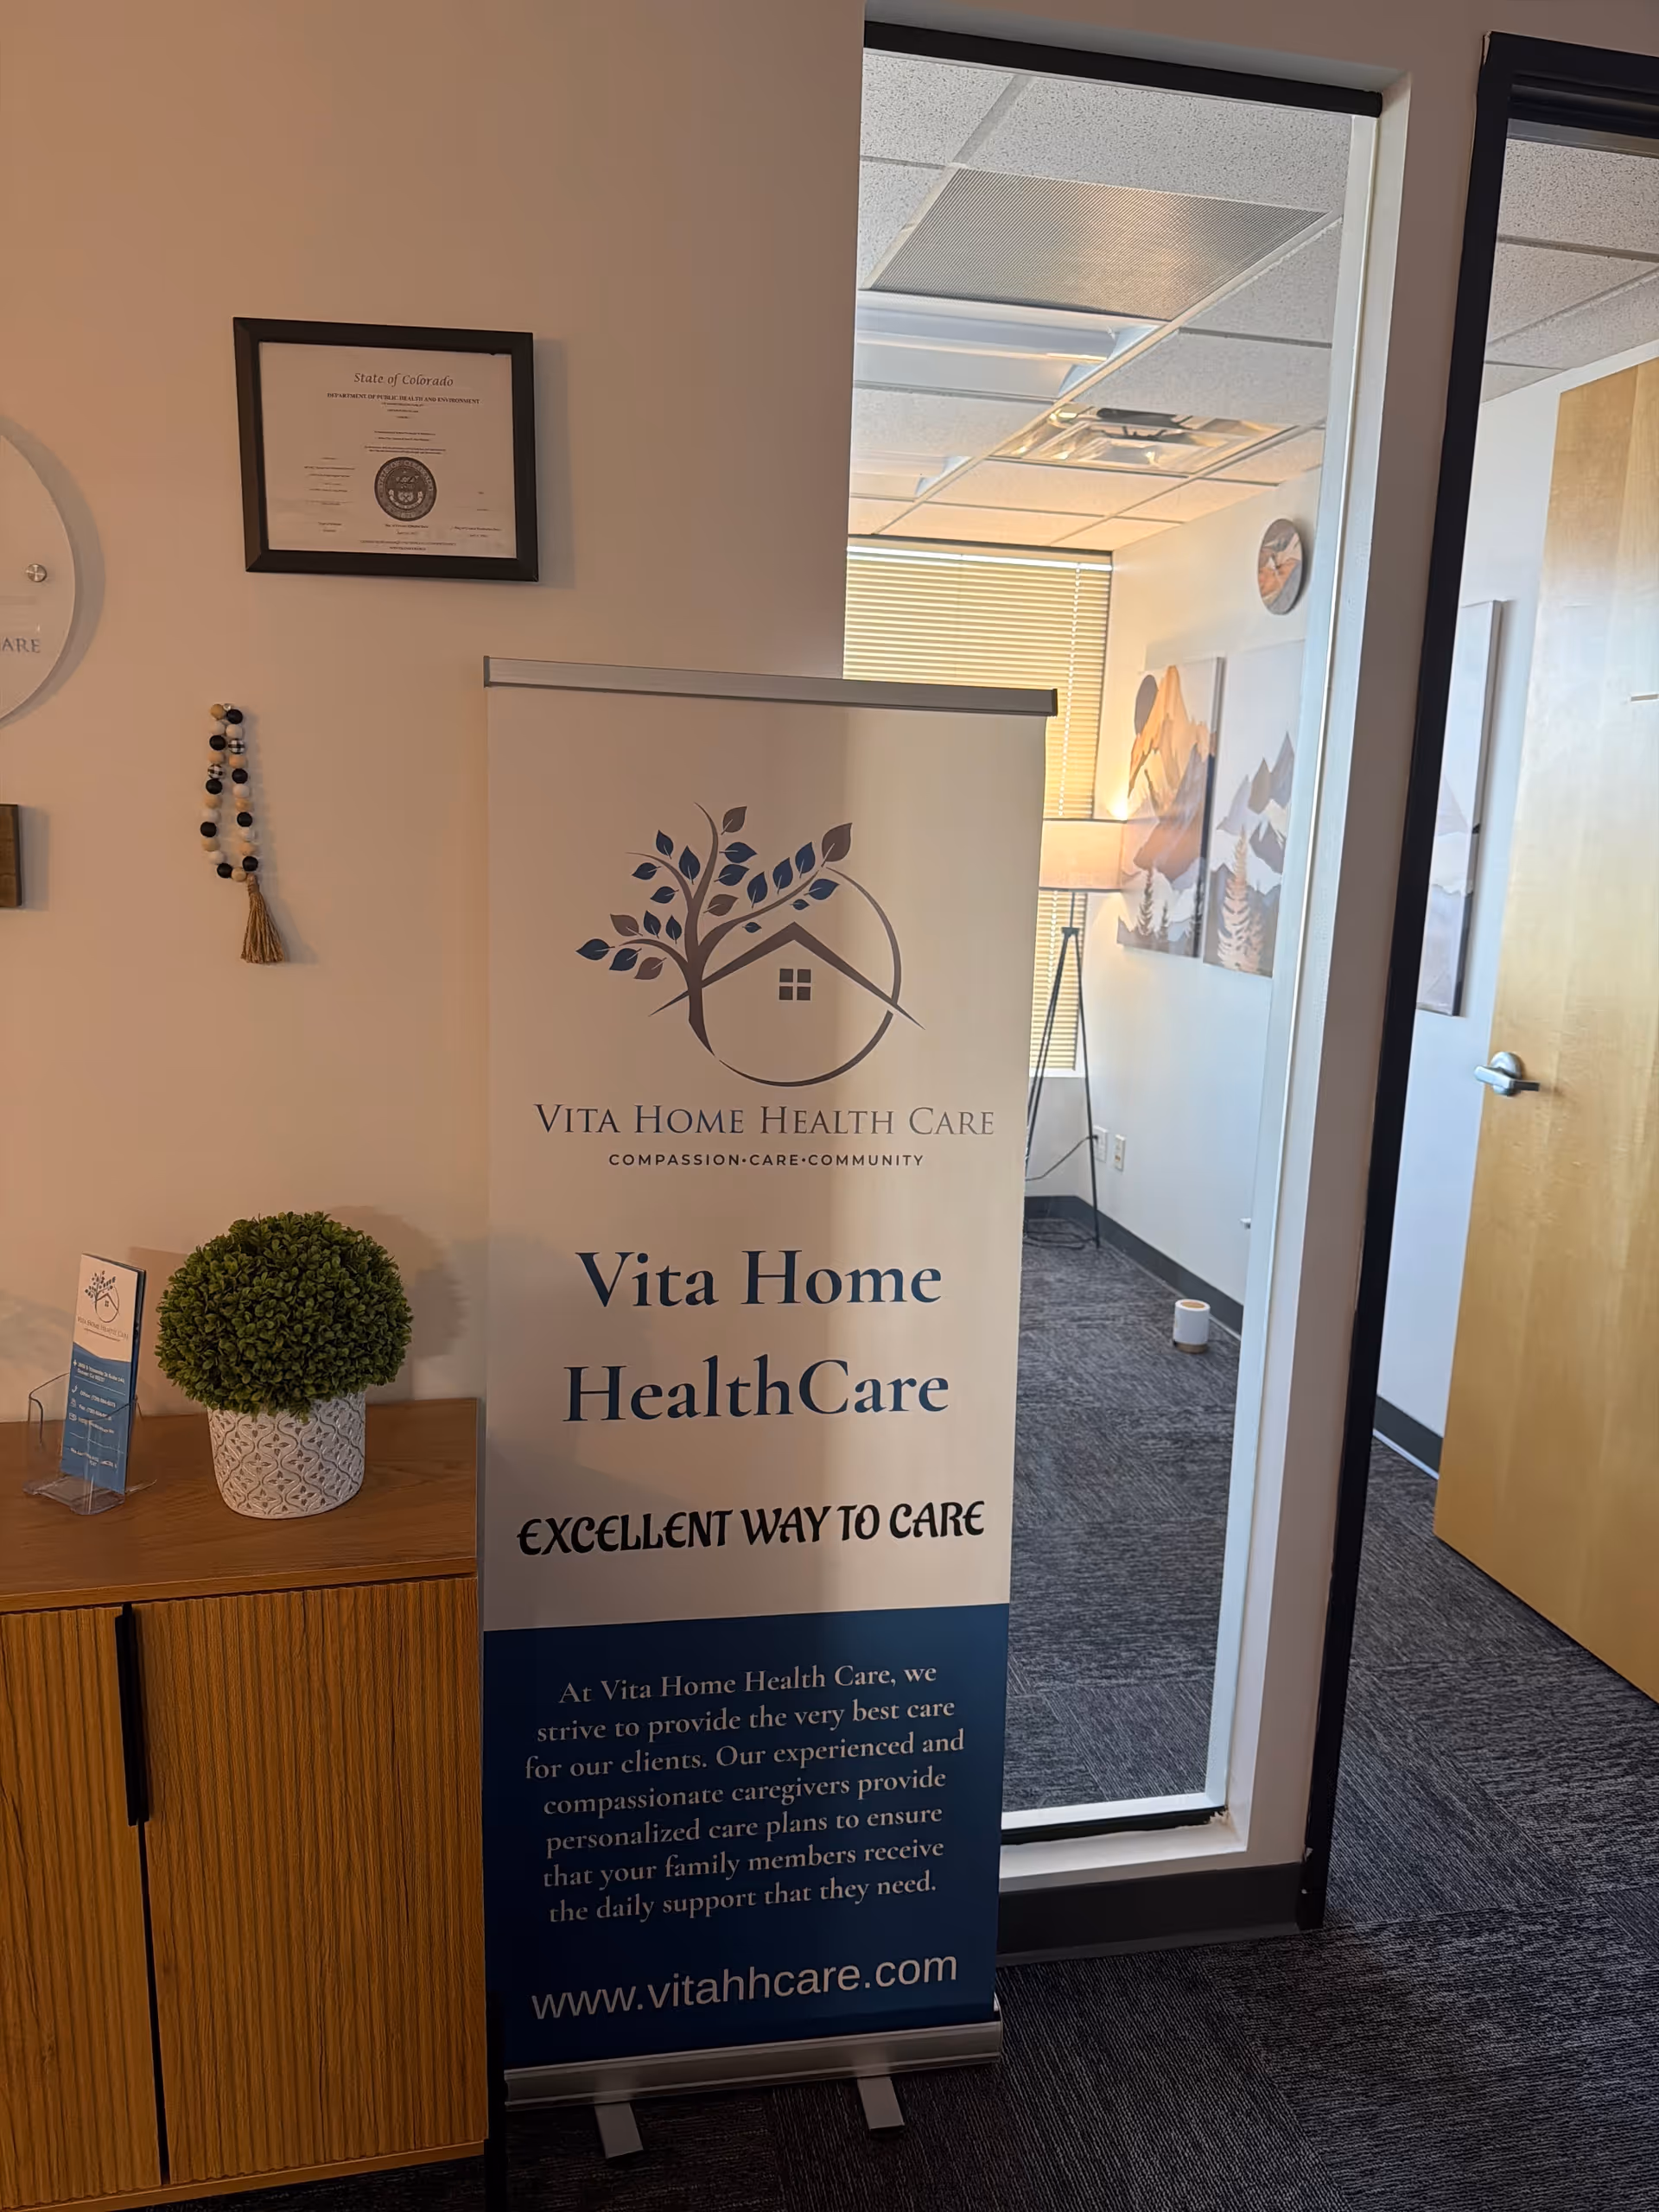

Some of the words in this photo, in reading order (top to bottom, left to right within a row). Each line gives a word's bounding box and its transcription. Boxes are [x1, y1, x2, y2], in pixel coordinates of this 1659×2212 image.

[353, 372, 384, 384] State
[387, 373, 401, 387] of
[402, 374, 454, 386] Colorado
[0, 637, 41, 653] ARE
[533, 1104, 620, 1133] VITA
[634, 1105, 743, 1134] HOME
[760, 1106, 893, 1134] HEALTH
[909, 1107, 994, 1135] CARE
[575, 1252, 719, 1307] Vita
[741, 1250, 941, 1304] Home
[563, 1354, 948, 1421] HealthCare
[517, 1510, 733, 1555] EXCELLENT
[741, 1506, 831, 1545] WAY
[837, 1504, 880, 1541] TO
[890, 1501, 984, 1539] CARE
[559, 1682, 591, 1703] At
[601, 1680, 652, 1700] Vita
[660, 1676, 735, 1696] Home
[746, 1665, 825, 1691] Health
[835, 1665, 895, 1687] Care,
[904, 1669, 936, 1681] we
[537, 1720, 606, 1741] strive
[615, 1719, 639, 1737] to
[649, 1707, 741, 1742] provide
[750, 1705, 786, 1728] the
[794, 1709, 844, 1731] very
[853, 1699, 899, 1721] best
[907, 1703, 955, 1718] care
[525, 1756, 562, 1778] for
[570, 1761, 613, 1776] our
[621, 1750, 707, 1773] clients.
[716, 1745, 766, 1766] Our
[774, 1732, 913, 1769] experienced
[923, 1728, 964, 1752] and
[544, 1788, 723, 1819] compassionate
[732, 1777, 849, 1805] caregivers
[858, 1765, 945, 1800] provide
[547, 1818, 699, 1859] personalized
[709, 1823, 758, 1838] care
[767, 1811, 827, 1841] plans
[836, 1811, 859, 1828] to
[867, 1809, 942, 1826] ensure
[544, 1864, 593, 1886] that
[599, 1866, 657, 1891] your
[665, 1851, 740, 1880] family
[748, 1844, 855, 1870] members
[864, 1840, 944, 1861] receive
[550, 1899, 588, 1922] the
[597, 1893, 654, 1923] daily
[664, 1892, 756, 1918] support
[765, 1882, 811, 1904] that
[820, 1877, 869, 1904] they
[878, 1870, 936, 1894] need.
[531, 1956, 957, 2019] www.vitahhcare.com
